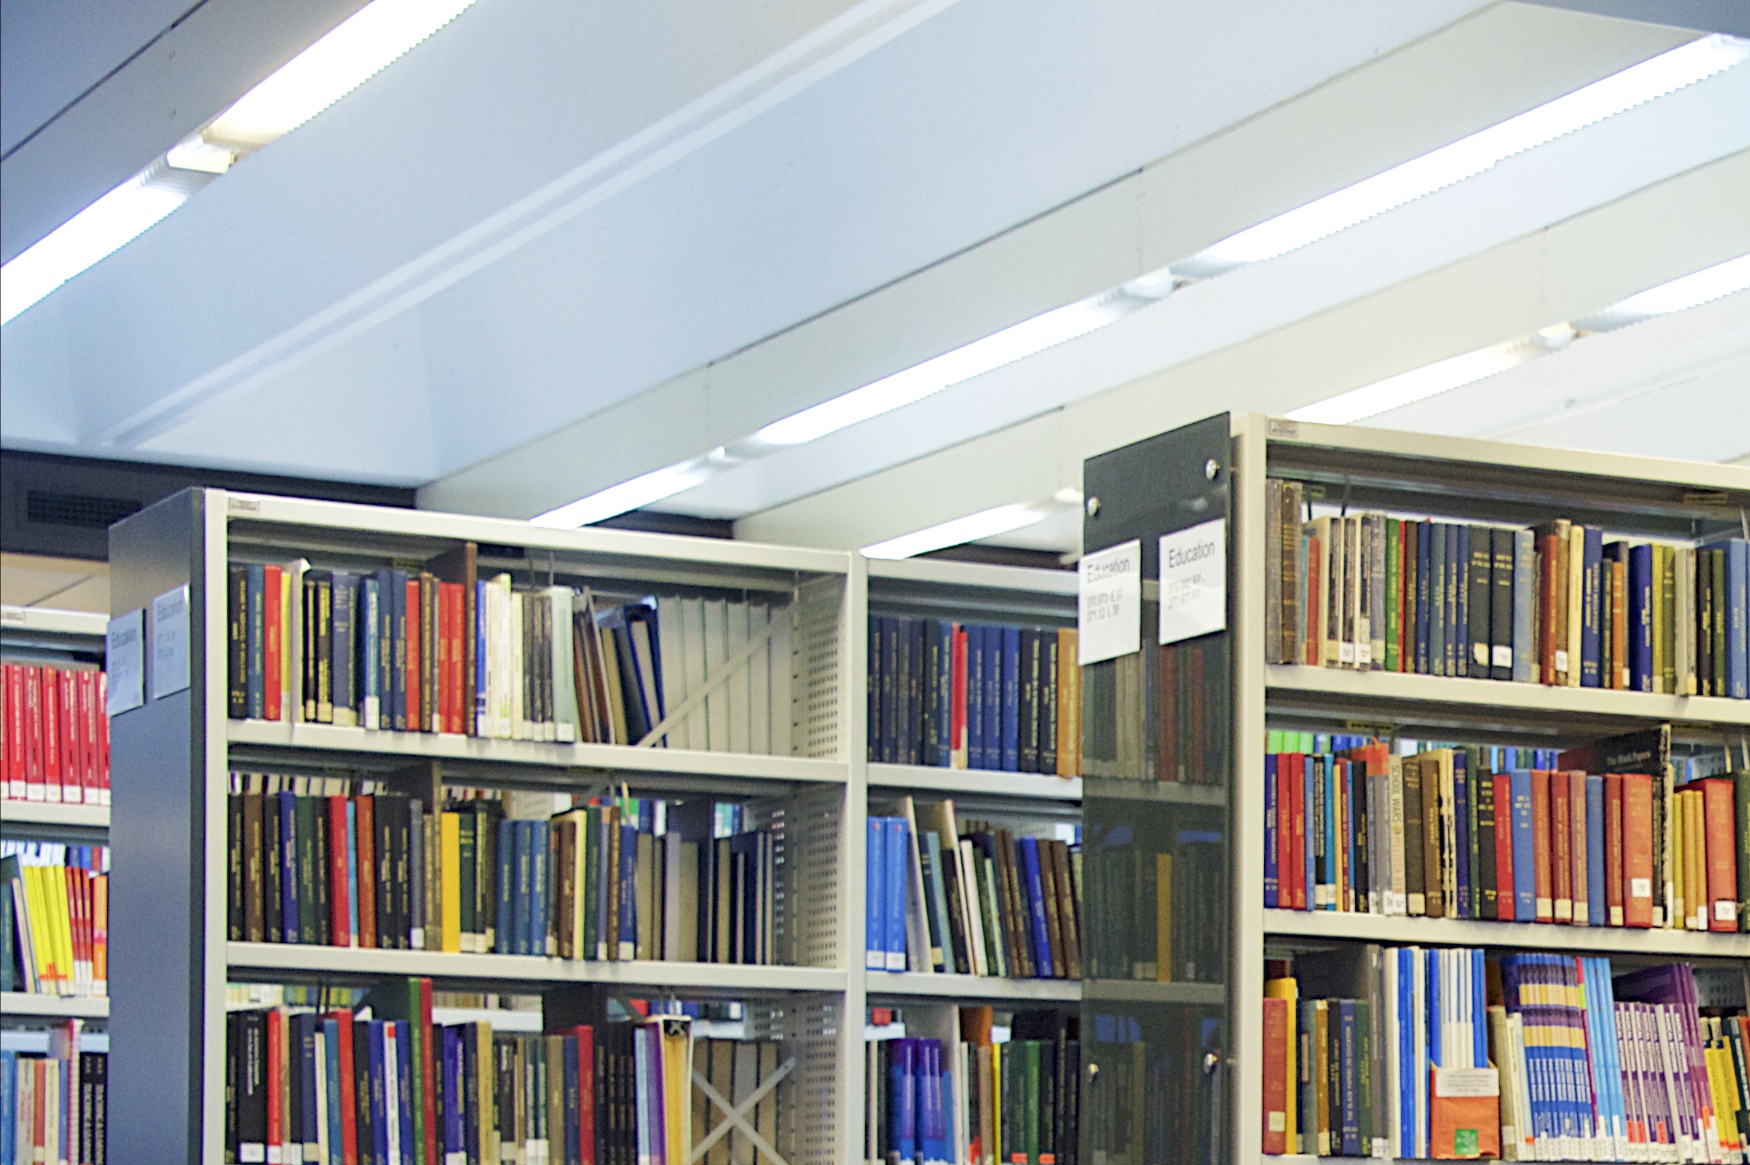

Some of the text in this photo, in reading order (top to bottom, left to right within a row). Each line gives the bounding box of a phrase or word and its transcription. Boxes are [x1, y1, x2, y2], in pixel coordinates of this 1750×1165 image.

[1169, 541, 1215, 568] Education
[1087, 558, 1130, 583] Education
[1391, 765, 1401, 796] SCHOOL
[1391, 799, 1401, 823] WARS
